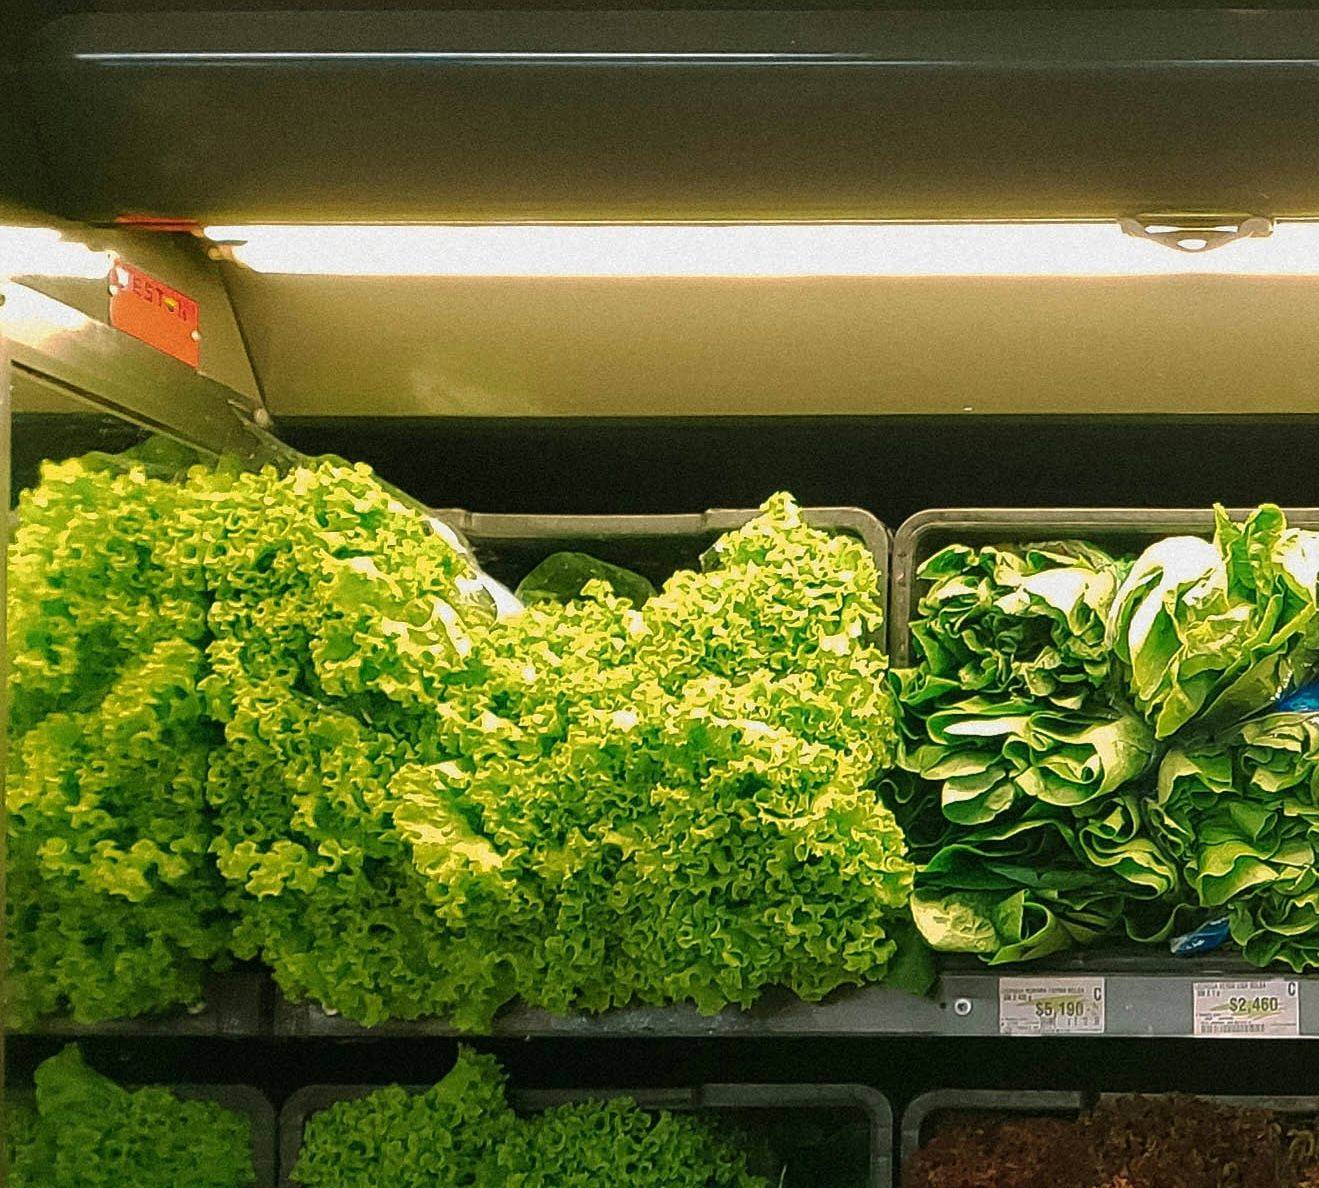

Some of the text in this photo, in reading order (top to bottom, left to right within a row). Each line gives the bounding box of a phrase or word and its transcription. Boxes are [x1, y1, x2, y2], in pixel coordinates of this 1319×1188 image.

[1289, 982, 1296, 996] C
[1036, 1001, 1084, 1018] $5,190
[1229, 996, 1278, 1013] $2,460
